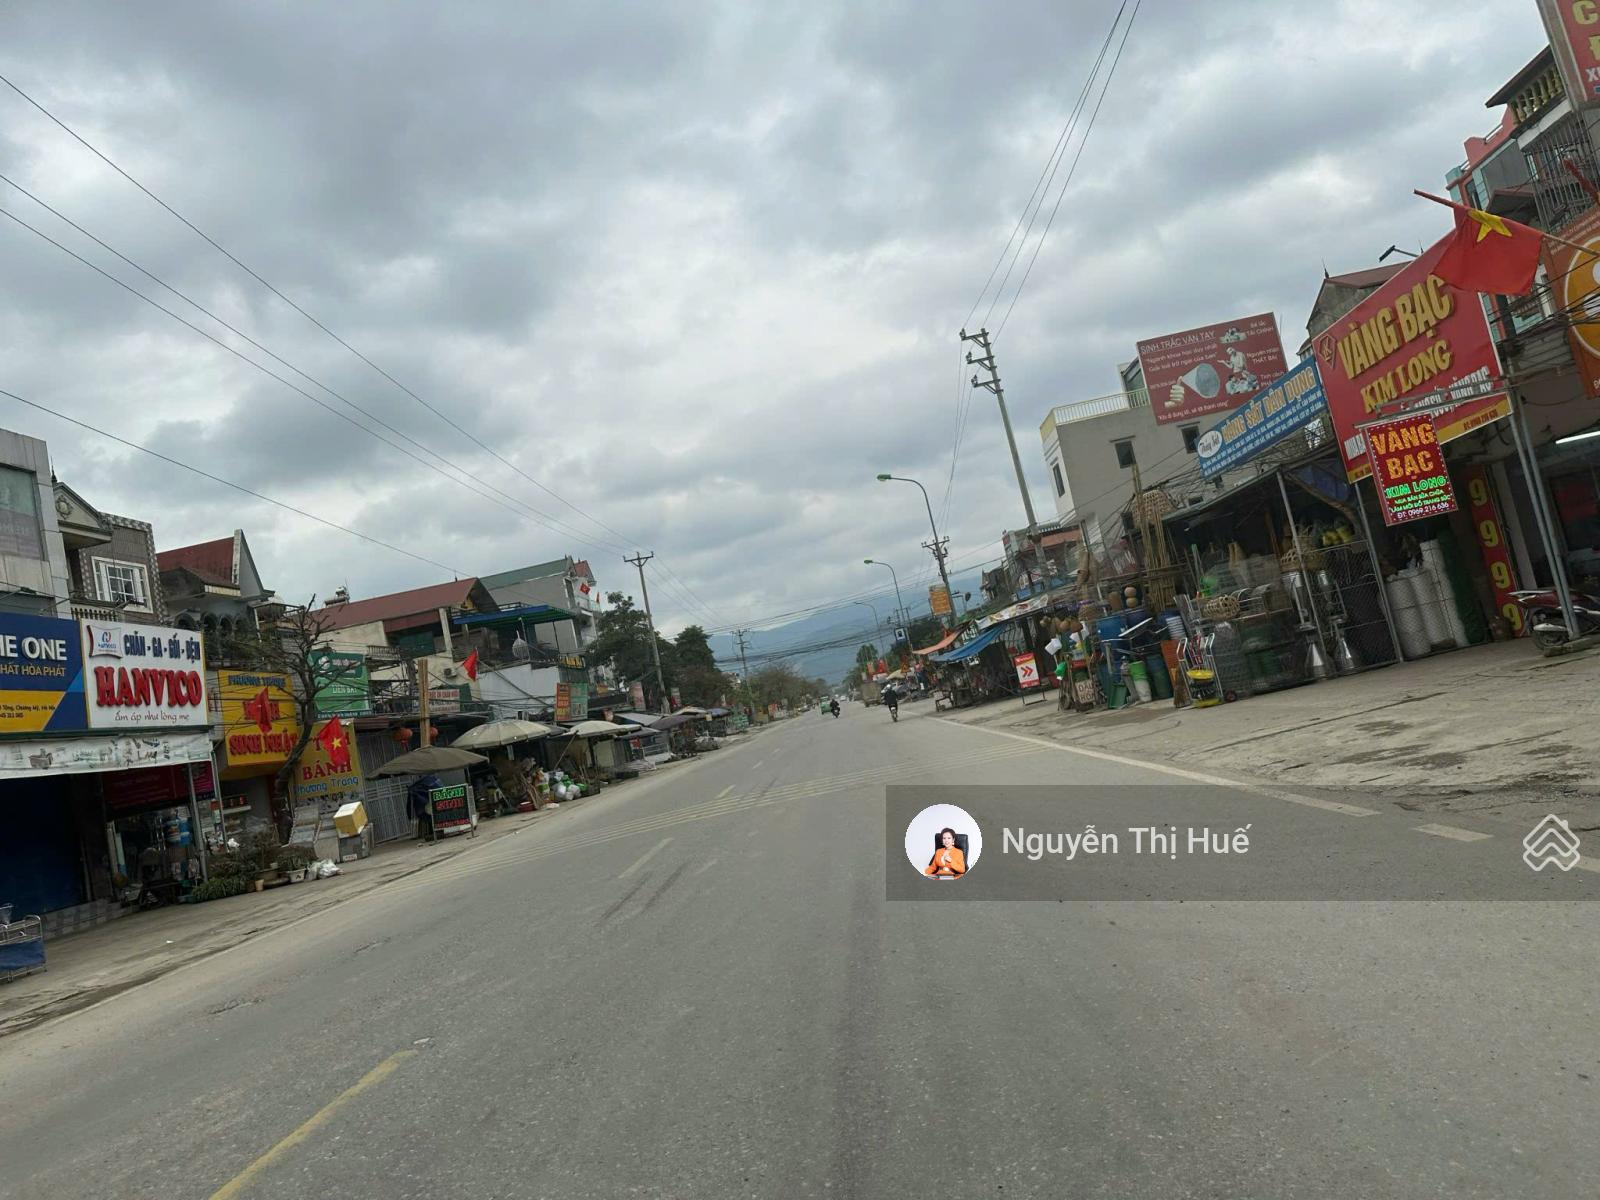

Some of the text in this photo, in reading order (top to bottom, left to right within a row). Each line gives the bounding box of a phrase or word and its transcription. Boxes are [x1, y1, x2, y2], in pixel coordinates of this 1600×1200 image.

[1337, 275, 1453, 380] VÀNG BẠC
[1284, 366, 1316, 402] DỤNG
[1360, 371, 1397, 414] KIM
[1397, 340, 1452, 394] LONG
[1371, 423, 1435, 455] VÀNG
[1386, 450, 1434, 479] BẠC
[1385, 475, 1447, 498] KIM LONG
[22, 636, 67, 660] ONE
[124, 630, 146, 656] CHĂN
[152, 637, 163, 658] GA
[168, 633, 181, 659] GỐI
[21, 661, 43, 676] HÒA
[43, 663, 67, 677] PHÁT
[94, 665, 203, 708] HANVICO
[229, 734, 262, 757] SINH
